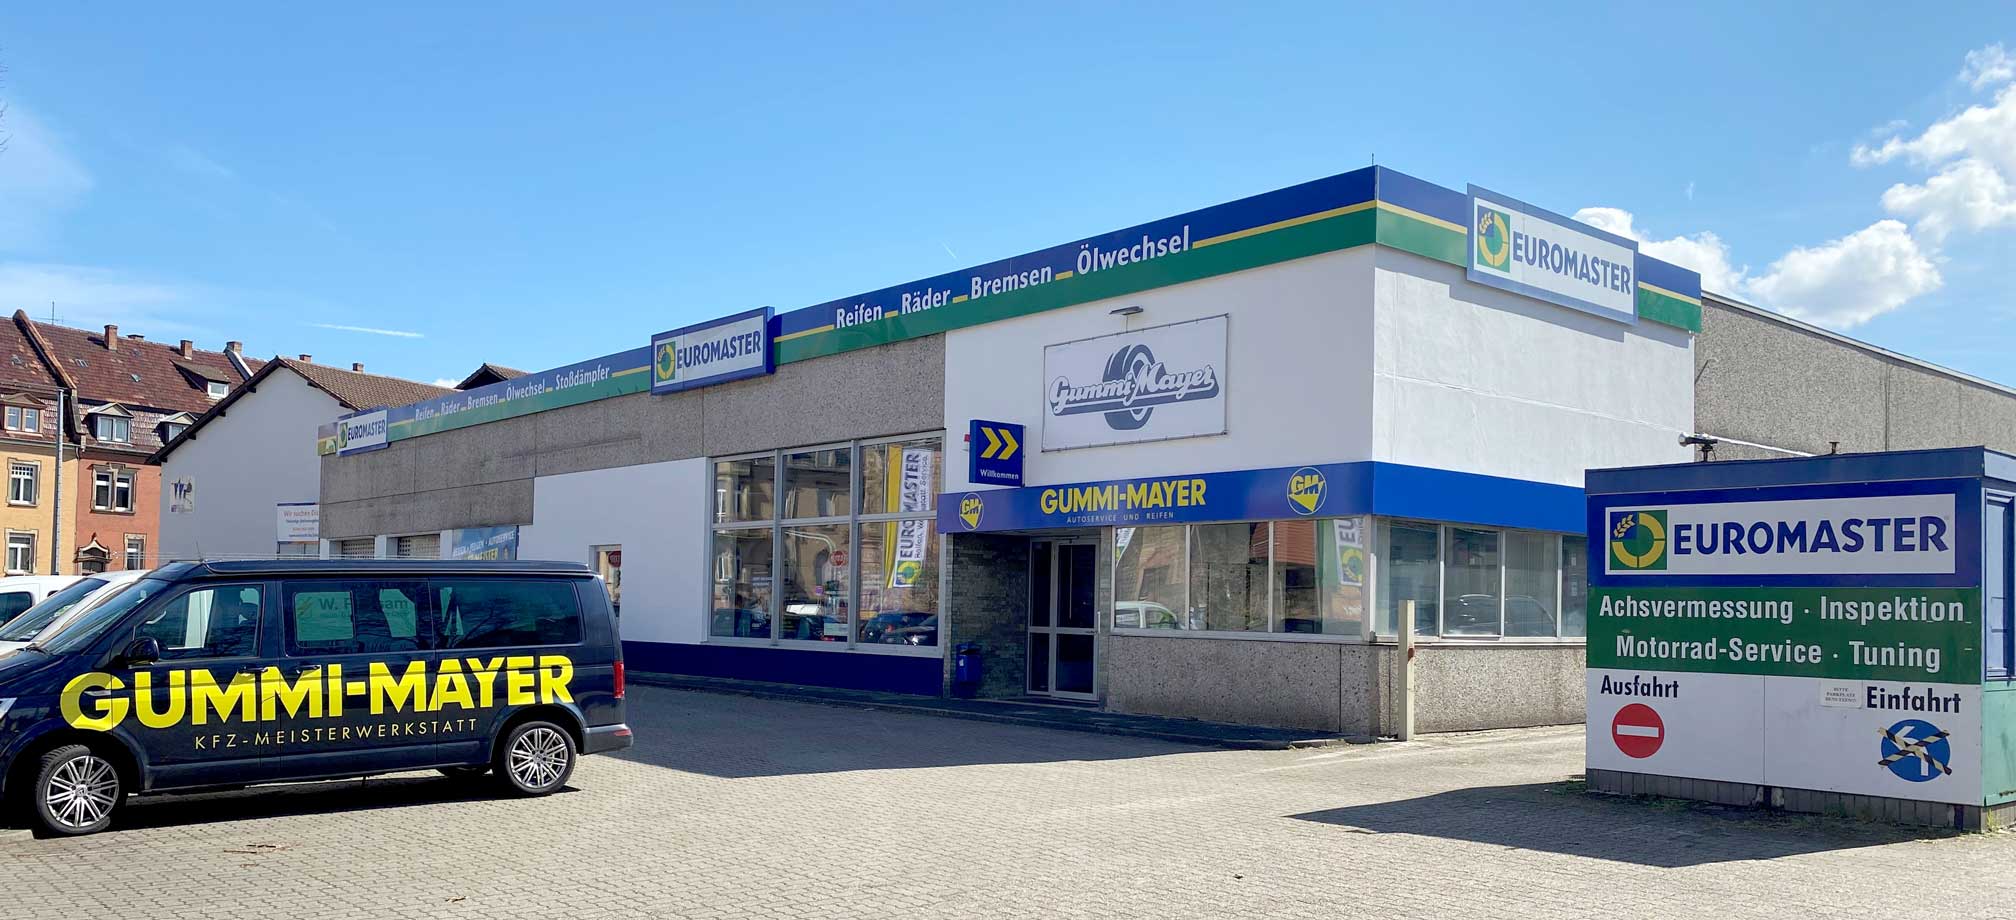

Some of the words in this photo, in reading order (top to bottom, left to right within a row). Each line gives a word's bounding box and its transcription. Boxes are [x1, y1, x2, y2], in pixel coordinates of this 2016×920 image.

[835, 303, 883, 329] Reifen
[901, 286, 951, 315] Räder
[971, 264, 1053, 300] Bremsen
[1077, 225, 1191, 275] Ölwechsel
[1512, 230, 1631, 295] EUROMASTER
[676, 330, 763, 370] EUROMASTER
[415, 404, 435, 422] Reifen
[440, 402, 461, 417] Räder
[467, 392, 498, 411] Bremsen
[506, 379, 546, 402] Ölwechsel
[555, 364, 611, 391] Stoßdämpfer
[347, 418, 387, 441] EUROMASTER
[980, 468, 1019, 480] Willkommen
[1040, 478, 1207, 515] GUMMI-MAYER
[1066, 514, 1117, 524] AUTOSERVICE
[1123, 512, 1140, 521] UND
[1146, 511, 1174, 520] REIFEN
[1674, 515, 1949, 556] EUROMASTER
[1599, 594, 1794, 625] Achsvermessung
[1820, 595, 1965, 625] Inspektion
[1616, 635, 1823, 664] Motorrad-Service
[1848, 640, 1941, 673] Tuning
[60, 655, 574, 731] GUMMI-MAYER
[1600, 674, 1679, 699] Ausfahrt
[1866, 686, 1961, 713] Einfahrt
[195, 718, 477, 750] KFZ-MEISTERWERKSTATT
